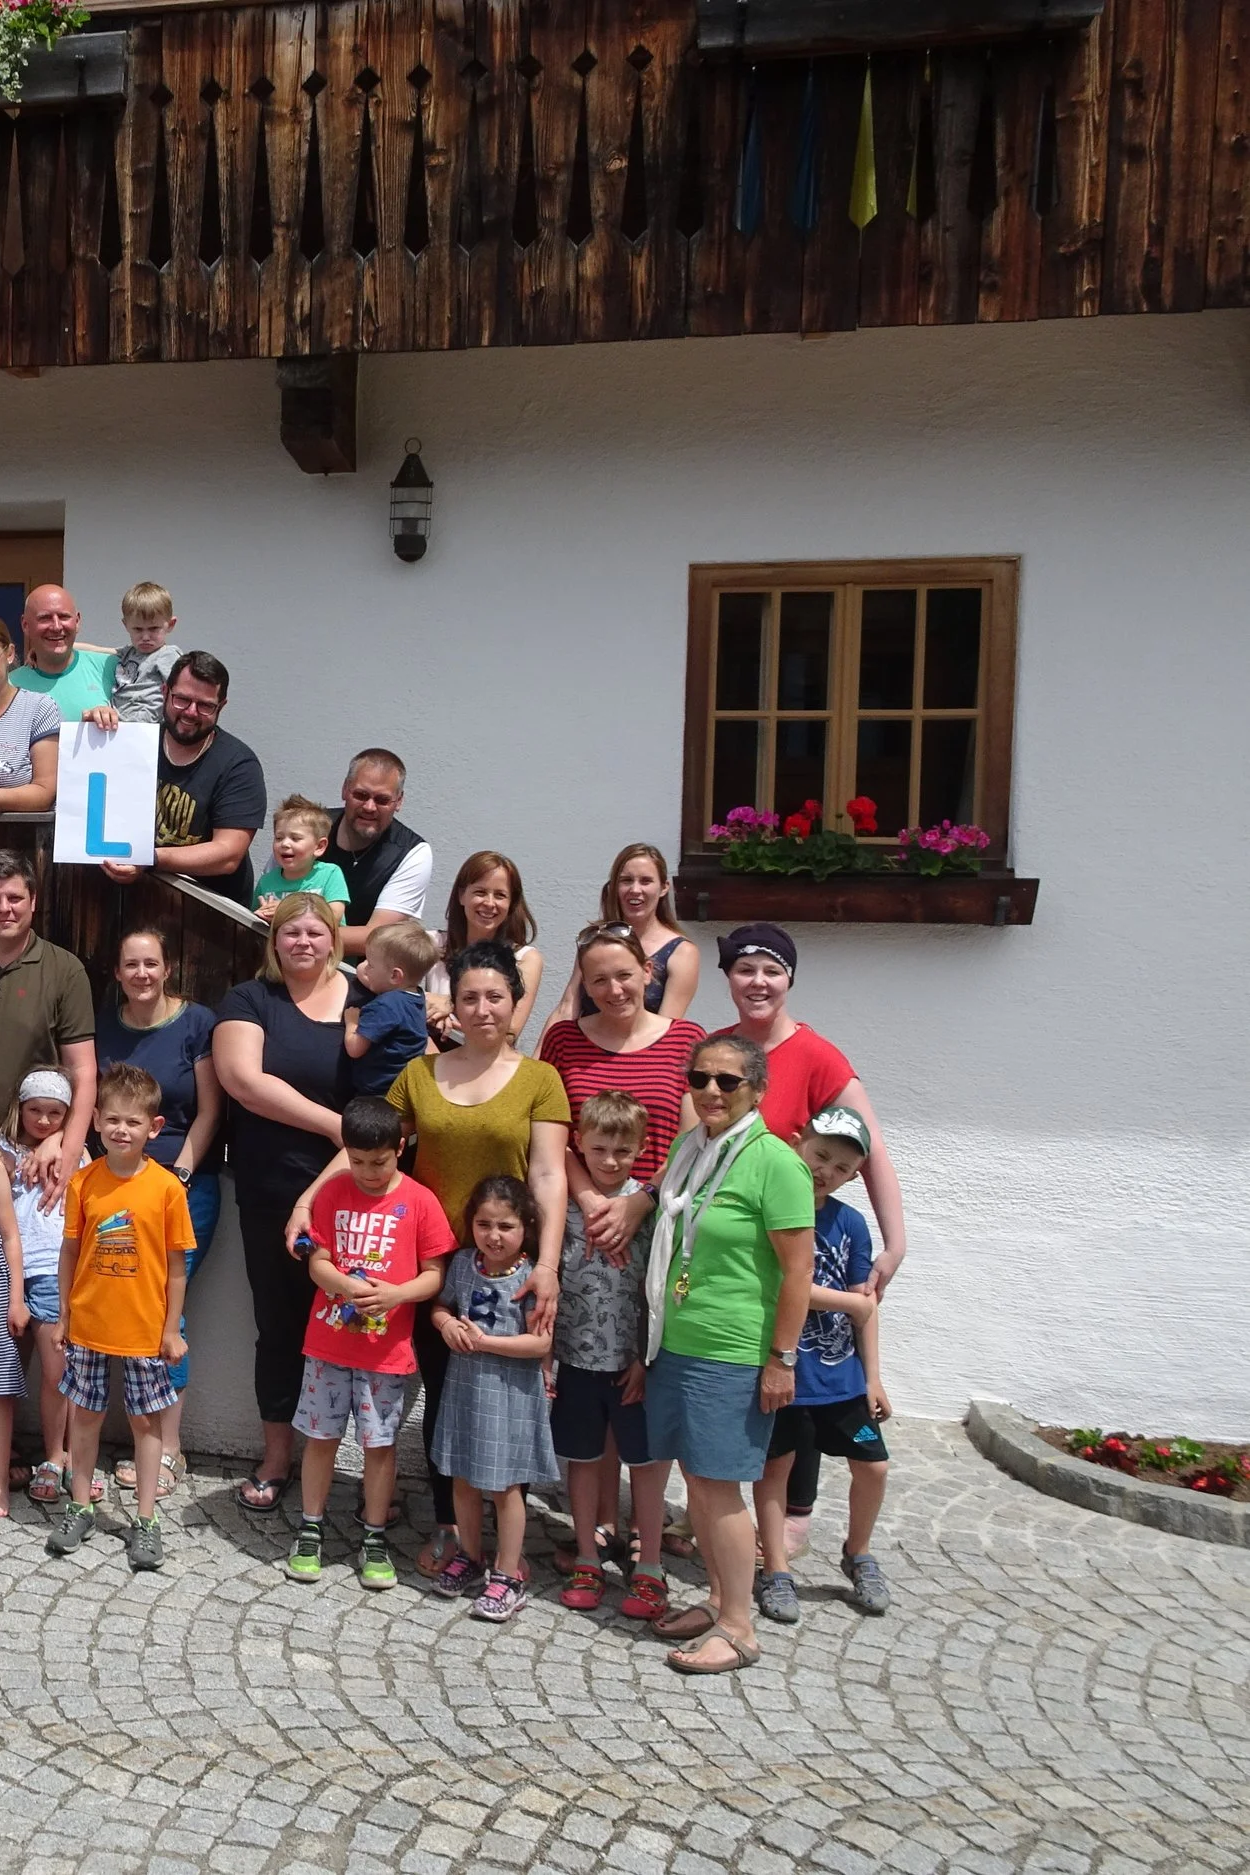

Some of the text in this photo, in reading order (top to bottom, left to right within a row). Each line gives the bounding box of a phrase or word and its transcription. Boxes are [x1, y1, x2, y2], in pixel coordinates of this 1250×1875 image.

[85, 771, 133, 857] L
[334, 1209, 401, 1236] RUFF
[335, 1231, 396, 1258] RUFF
